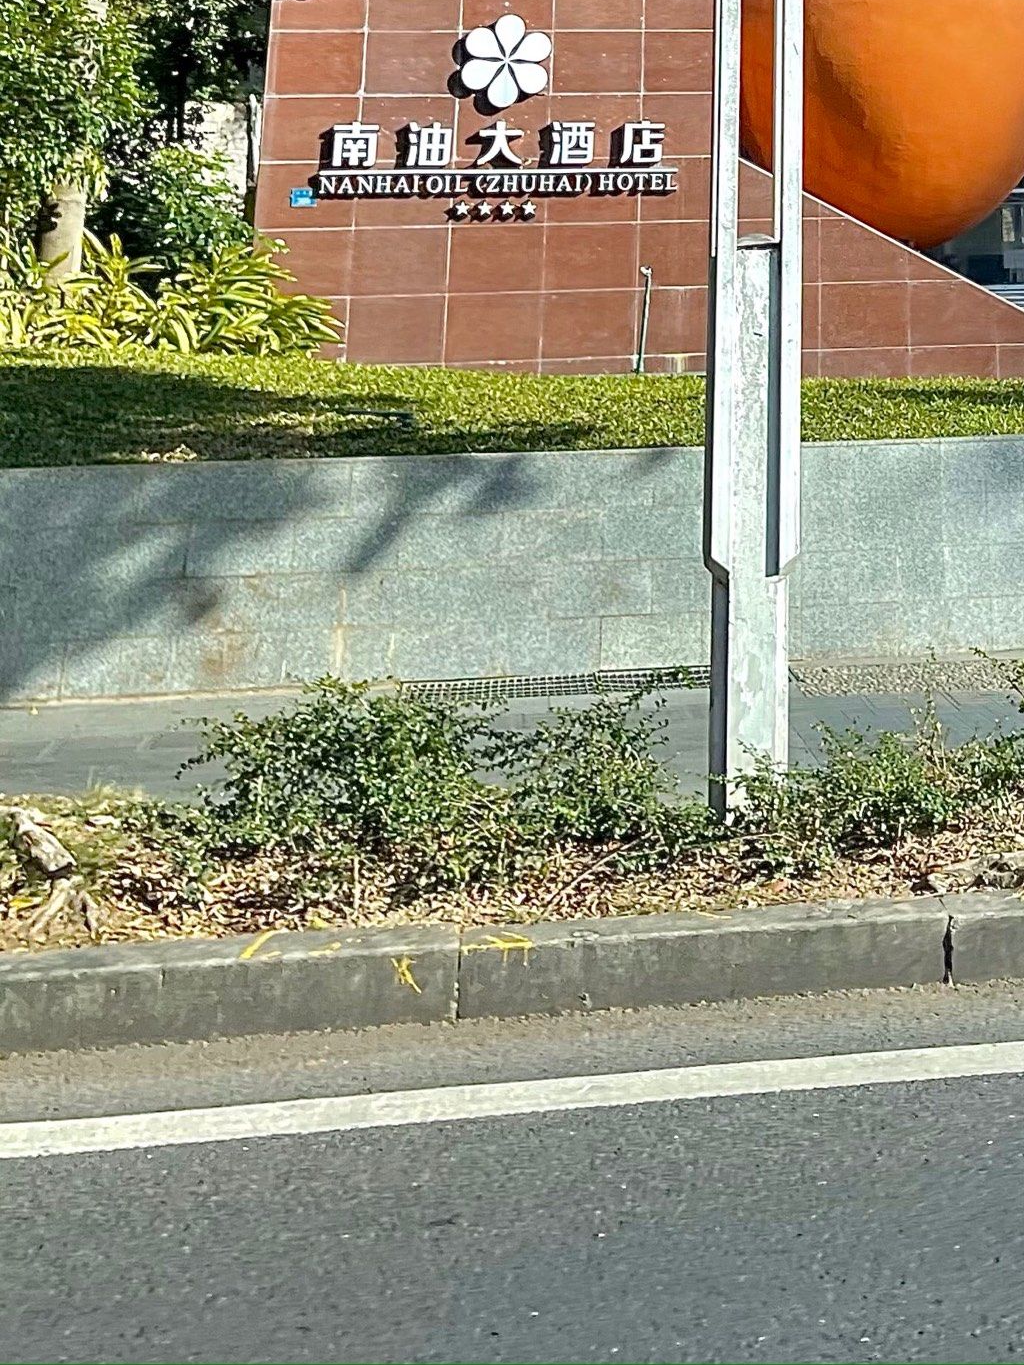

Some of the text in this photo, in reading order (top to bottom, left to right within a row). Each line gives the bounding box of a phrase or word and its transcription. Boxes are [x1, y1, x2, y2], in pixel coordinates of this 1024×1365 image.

[331, 120, 666, 167] 南油大酒店
[318, 173, 679, 194] NANHAI OIL (ZHUHAI) HOTEL
